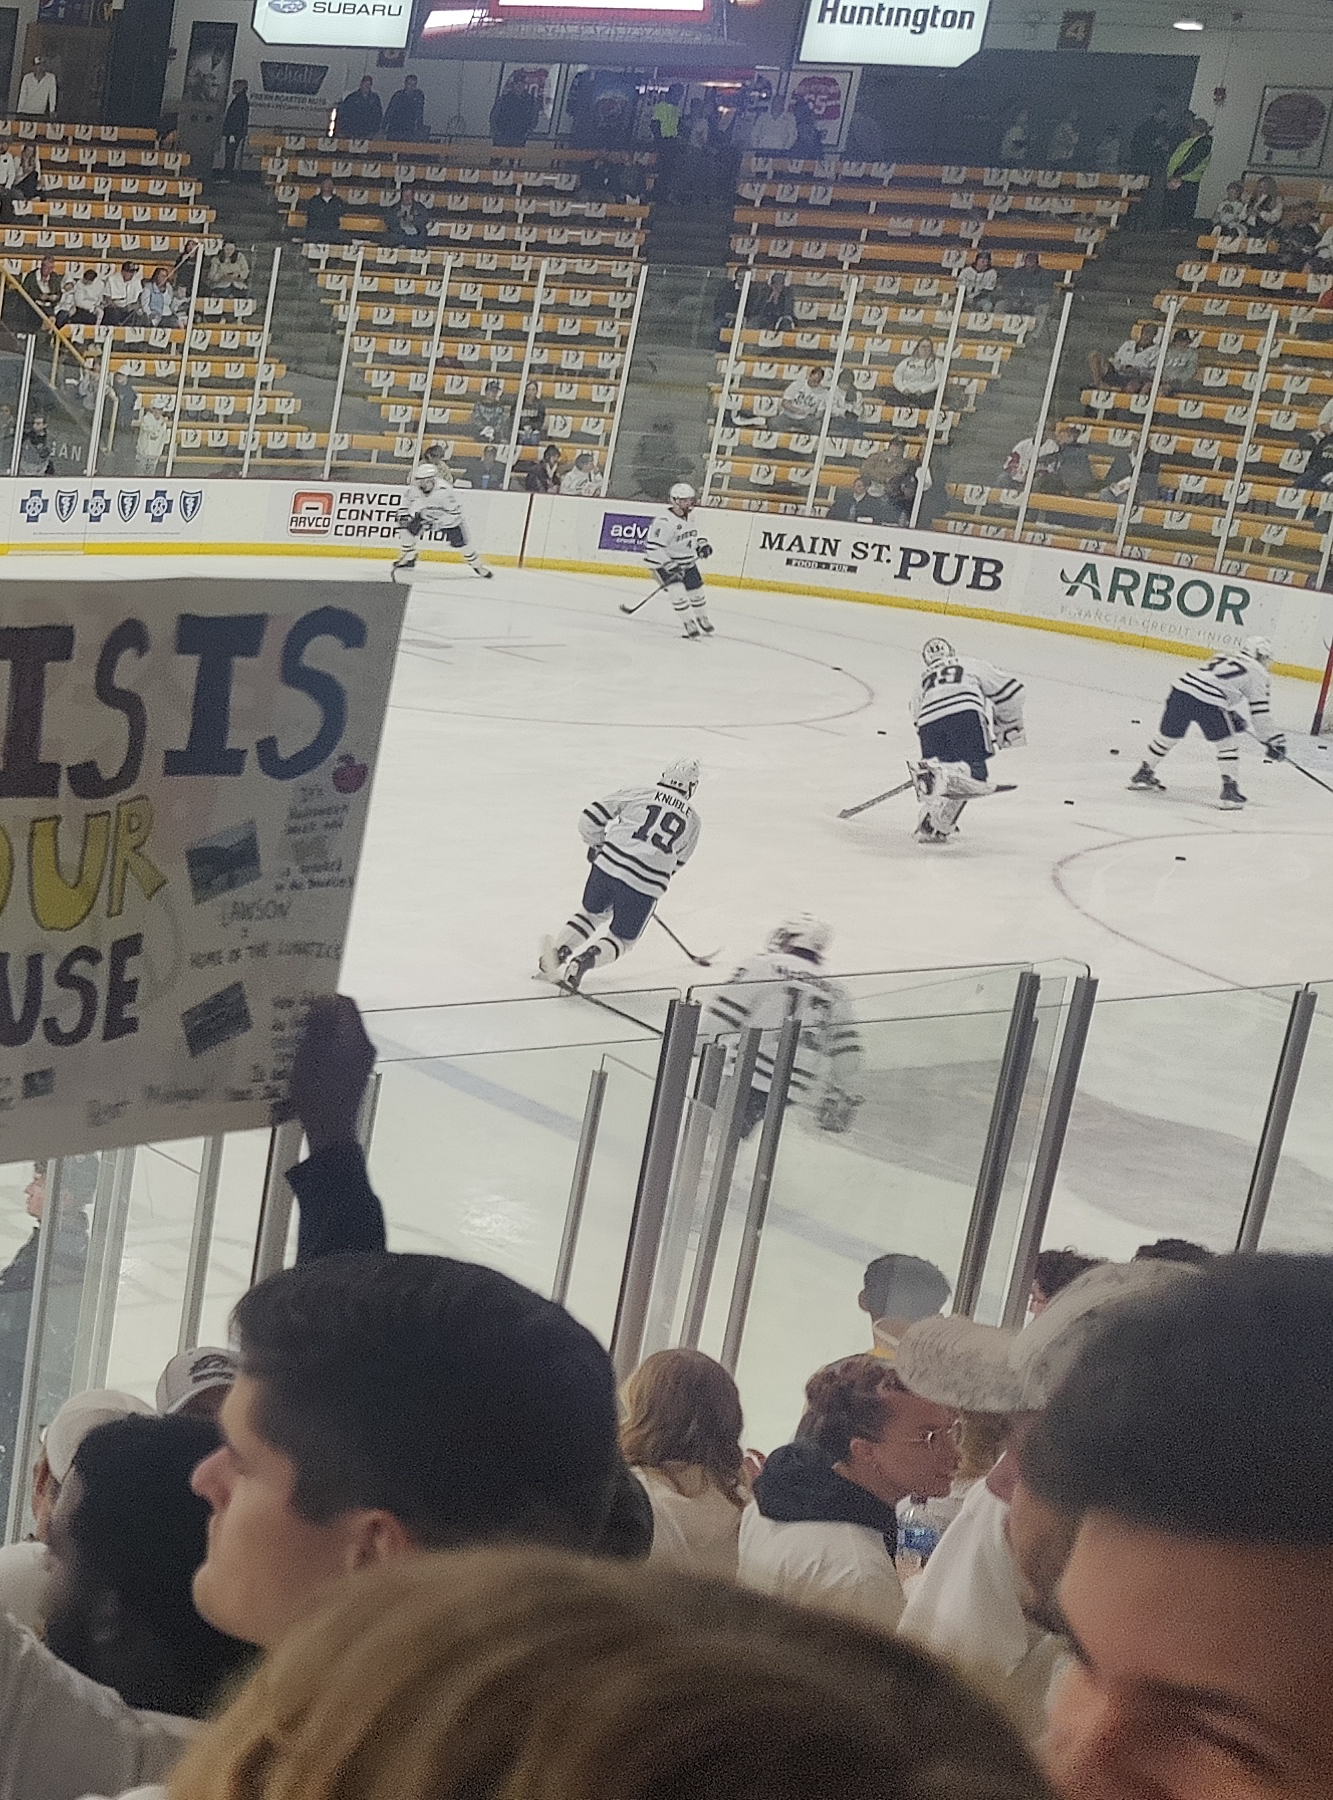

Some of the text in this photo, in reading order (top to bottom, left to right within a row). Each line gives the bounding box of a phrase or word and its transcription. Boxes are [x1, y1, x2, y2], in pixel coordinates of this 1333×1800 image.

[312, 1, 403, 17] SUBARU
[817, 0, 976, 34] Huntington
[338, 492, 402, 506] ARVCO
[289, 516, 331, 528] ARVCO
[759, 530, 1005, 592] MAIN ST. PUB
[791, 558, 819, 569] FOOD
[1060, 562, 1251, 626] ARBOR
[1140, 618, 1191, 639] CREDIT
[163, 605, 369, 782] IS
[631, 804, 687, 855] 19
